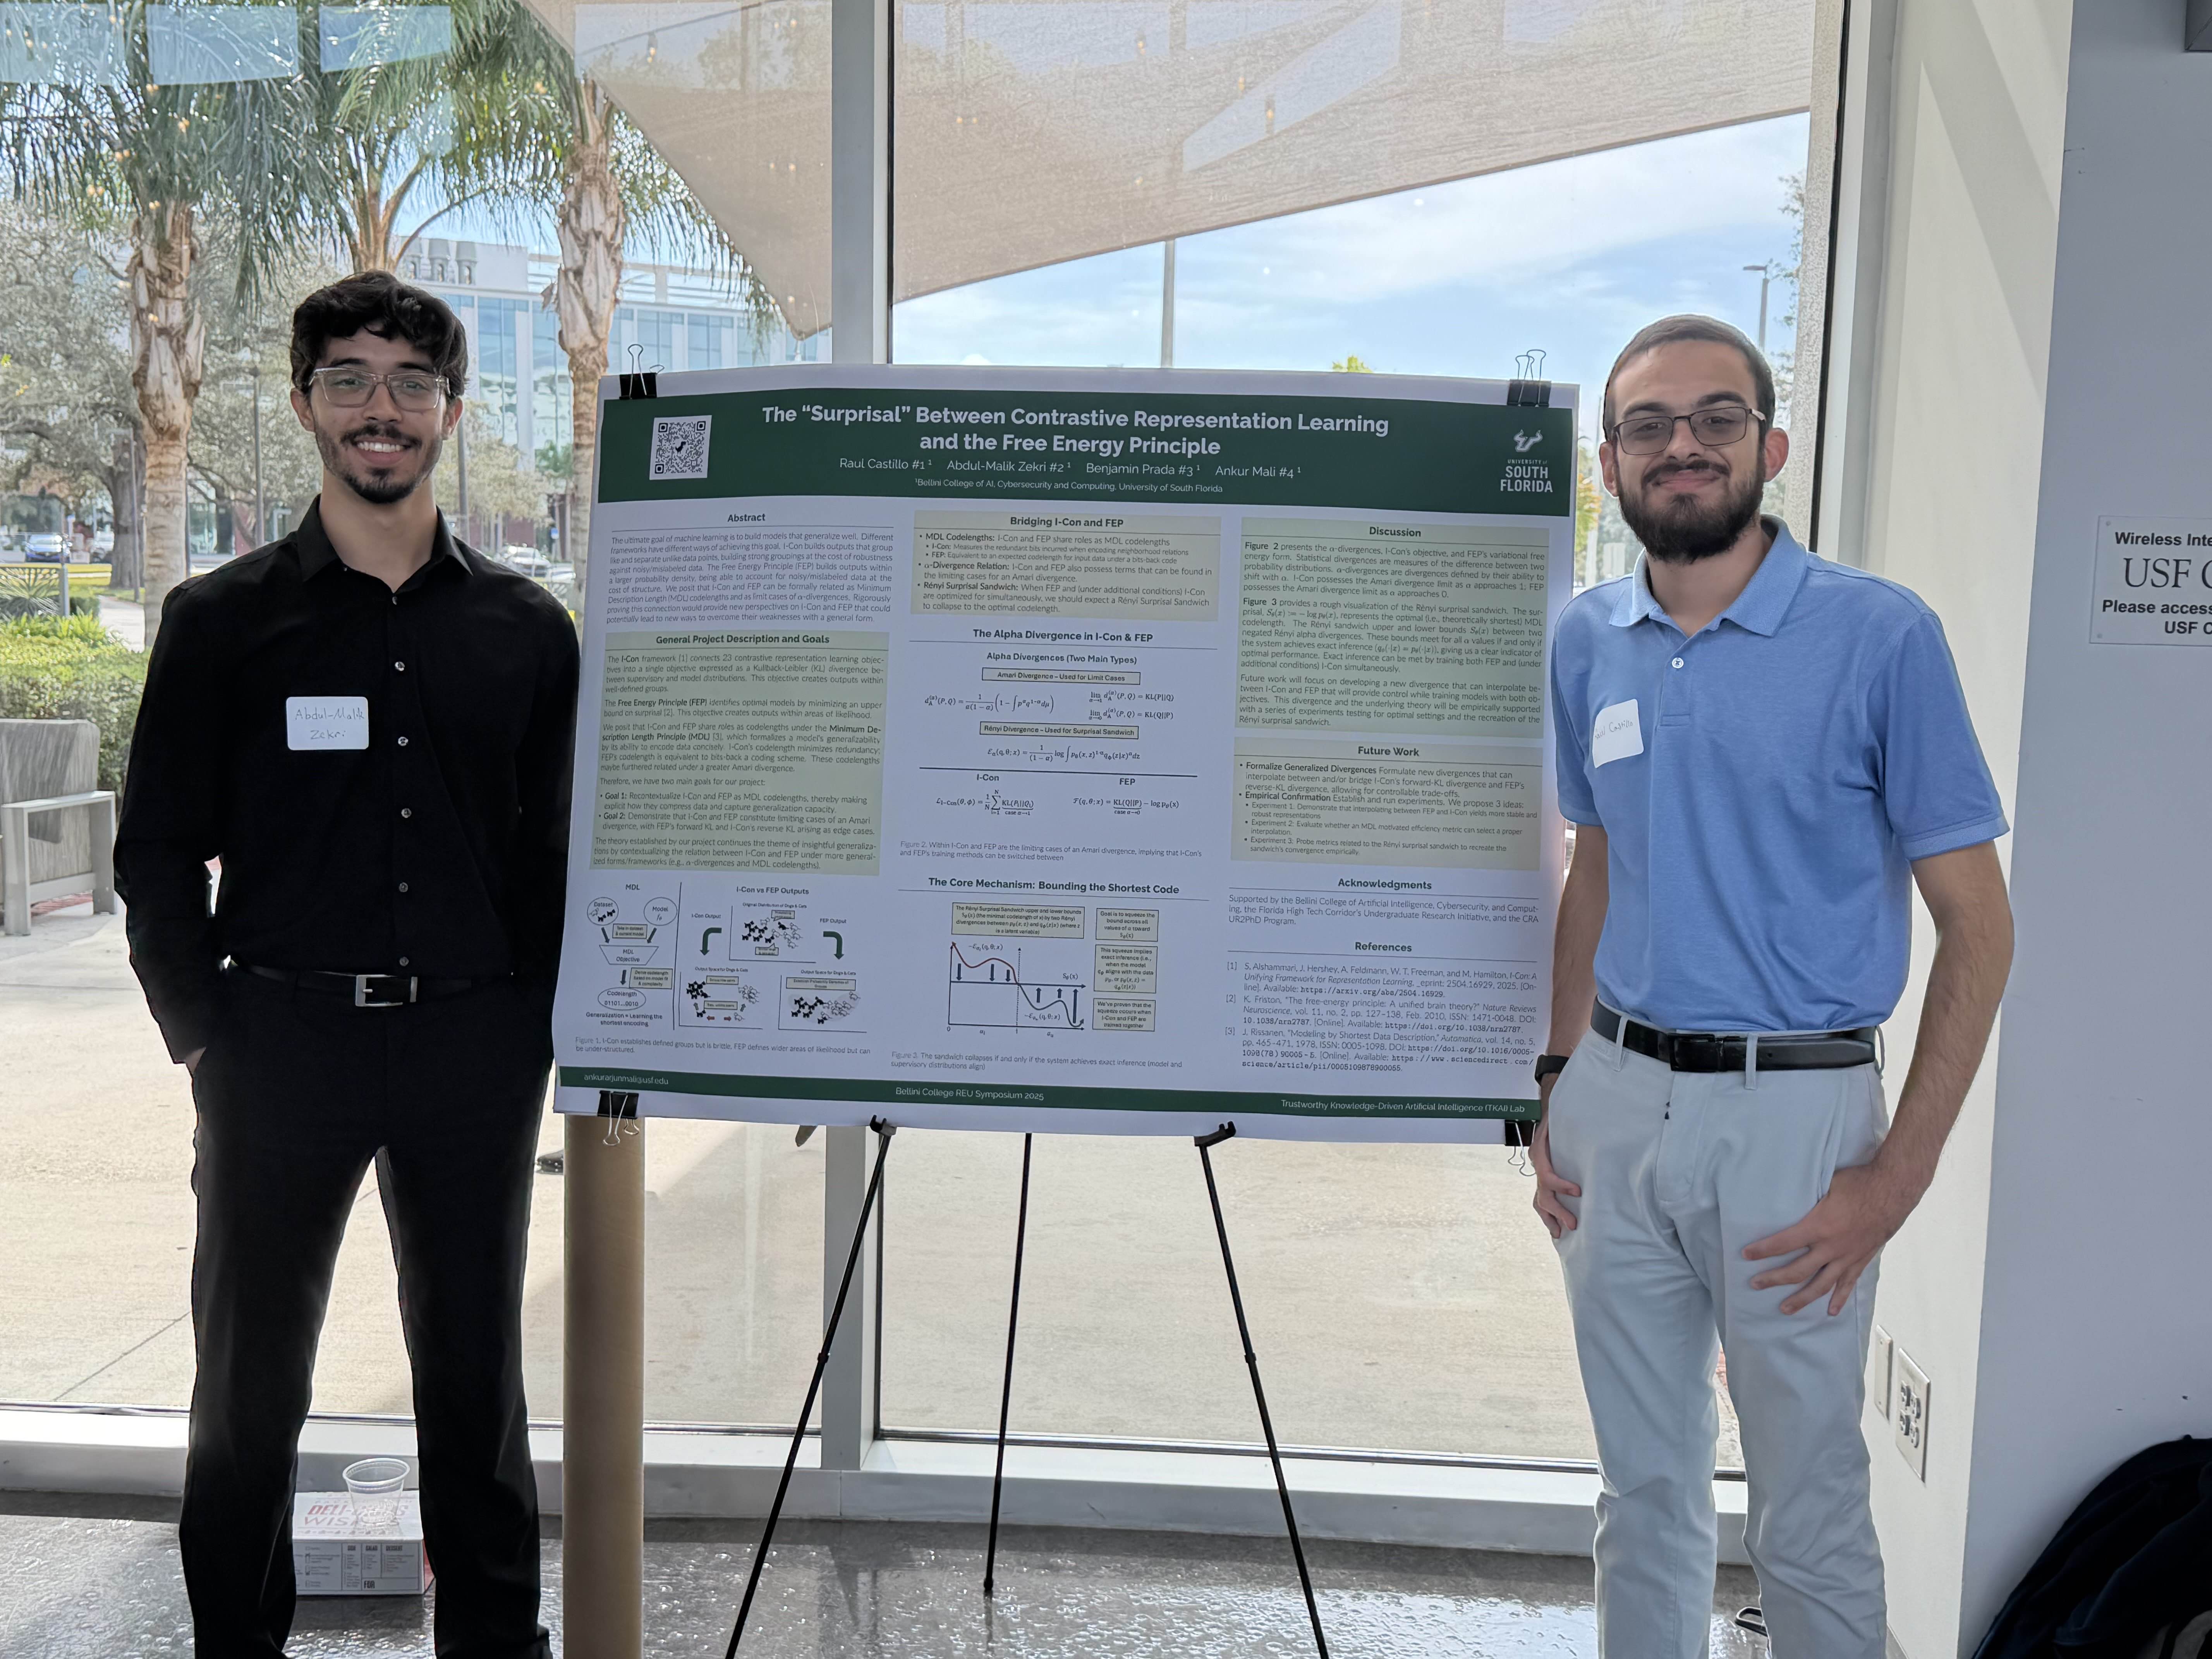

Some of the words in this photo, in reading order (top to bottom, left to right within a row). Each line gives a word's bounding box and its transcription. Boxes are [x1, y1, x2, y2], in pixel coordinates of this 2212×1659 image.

[762, 406, 797, 423] The
[916, 406, 1006, 424] Between
[1010, 408, 1129, 427] Contrastive
[1133, 410, 1292, 432] Representation
[1298, 413, 1389, 438] Learning
[919, 432, 958, 450] and
[963, 433, 998, 450] the
[1003, 434, 1048, 451] Free
[1053, 434, 1125, 458] Energy
[1129, 436, 1221, 459] Principle
[840, 457, 865, 469] Raul
[867, 458, 909, 469] Castillo
[912, 459, 926, 470] #1
[946, 460, 1015, 472] Abdul-Malik
[1018, 461, 1046, 472] Zekri
[1049, 462, 1064, 472] #2
[1086, 462, 1139, 476] Benjamin
[1142, 464, 1175, 475] Prada
[1178, 465, 1194, 477] #3
[1215, 465, 1250, 476] Ankur
[1252, 466, 1276, 477] Mali
[1279, 467, 1294, 479] #4
[1505, 465, 1548, 479] SOUTH
[943, 479, 974, 489] College
[975, 479, 985, 488] of
[997, 480, 1053, 490] Cybersecurity
[1119, 483, 1159, 493] University
[1159, 483, 1169, 492] of
[1170, 484, 1194, 492] South
[1195, 484, 1223, 493] Florida
[1500, 479, 1553, 493] FLORIDA
[727, 513, 766, 523] Abstract
[1010, 516, 1053, 528] Bridging
[1054, 517, 1082, 527] I-Con
[1083, 518, 1103, 527] and
[1105, 518, 1124, 528] FEP
[1369, 526, 1422, 538] Discussion
[2115, 532, 2182, 546] Wireless
[926, 532, 945, 541] MDL
[946, 532, 995, 543] Codelengths:
[998, 534, 1018, 542] I-Con
[1036, 534, 1051, 543] FEP
[1074, 536, 1093, 544] roles
[1104, 536, 1123, 545] MDL
[1125, 538, 1170, 547] codelengths
[1245, 541, 1269, 551] Figure
[1273, 542, 1279, 550] 2
[1315, 543, 1328, 552] the
[1489, 551, 1528, 560] variational
[1530, 552, 1545, 560] free
[2123, 558, 2192, 588] USF
[2102, 599, 2156, 613] Please
[2164, 621, 2198, 634] USF
[656, 635, 691, 644] General
[692, 634, 725, 645] Project
[726, 634, 780, 645] Description
[781, 634, 800, 643] and
[802, 634, 830, 644] Goals
[972, 629, 992, 638] The
[993, 629, 1023, 641] Alpha
[1025, 630, 1082, 642] Divergence
[1084, 631, 1093, 641] in
[1095, 632, 1122, 641] I-Con
[1124, 633, 1132, 642] &
[1134, 633, 1154, 642] FEP
[986, 652, 1012, 661] Alpha
[1013, 653, 1065, 663] Divergences
[1066, 654, 1086, 663] (Two
[1087, 654, 1108, 663] Main
[1109, 655, 1137, 666] Types)
[295, 707, 365, 720] Abdul-Malik
[1609, 720, 1633, 732] Castillo
[310, 729, 346, 740] Zekri
[1358, 745, 1391, 756] Future
[1393, 747, 1420, 757] Work
[1246, 761, 1283, 771] Formalize
[1284, 763, 1329, 772] Generalized
[1331, 764, 1377, 775] Divergences
[1379, 766, 1417, 776] Formulate
[1436, 769, 1480, 778] divergences
[1482, 770, 1497, 778] that
[976, 773, 1000, 781] I-Con
[1119, 778, 1136, 786] FEP
[780, 887, 809, 896] Outputs
[928, 877, 948, 886] The
[949, 878, 974, 887] Core
[975, 878, 1036, 890] Mechanism:
[1038, 881, 1087, 893] Bounding
[1089, 882, 1106, 891] the
[1108, 883, 1151, 893] Shortest
[1152, 884, 1180, 894] Code
[1338, 878, 1432, 891] Acknowledgments
[1229, 894, 1268, 904] Supported
[1270, 895, 1280, 905] by
[1281, 896, 1294, 905] the
[1295, 896, 1317, 905] Bellini
[1319, 897, 1347, 907] College
[1348, 898, 1357, 907] of
[1358, 898, 1389, 908] Artificial
[1507, 904, 1539, 913] Comput-
[1229, 915, 1262, 924] UR2PhD
[1264, 916, 1297, 926] Program.
[1355, 941, 1412, 952] References
[895, 1087, 921, 1096] Bellini
[922, 1087, 955, 1099] College
[955, 1089, 974, 1097] REU
[975, 1089, 1023, 1100] Symposium
[1024, 1092, 1044, 1101] 2025
[1281, 1099, 1329, 1111] Trustworthy
[1330, 1101, 1403, 1112] Knowledge-Driven
[1405, 1102, 1436, 1111] Artificial
[1437, 1103, 1484, 1113] Intelligence
[1510, 1104, 1525, 1113] Lab
